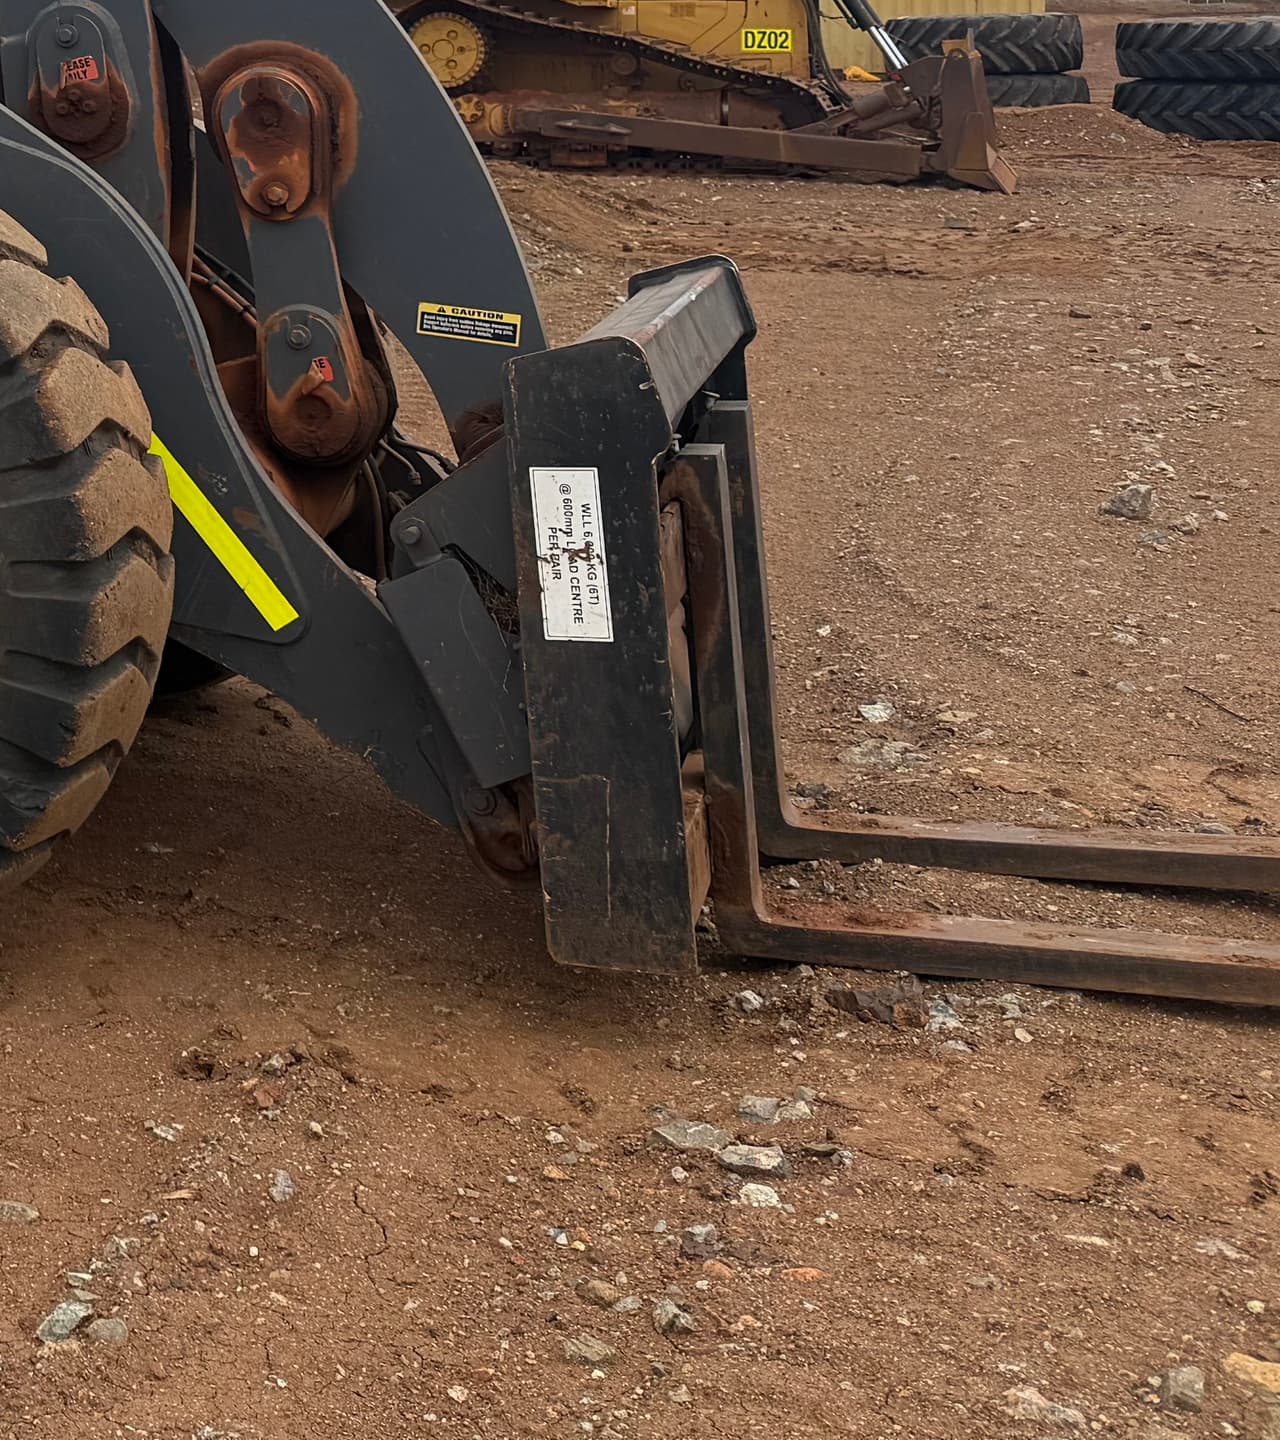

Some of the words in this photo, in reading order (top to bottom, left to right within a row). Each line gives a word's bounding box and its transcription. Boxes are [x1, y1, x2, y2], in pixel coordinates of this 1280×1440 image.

[744, 30, 790, 49] DZ02
[451, 307, 504, 320] CAUTION
[580, 503, 591, 528] WLL
[558, 483, 572, 496] @
[570, 579, 585, 625] CENTRE
[586, 563, 597, 581] KG
[587, 584, 600, 605] (6T)
